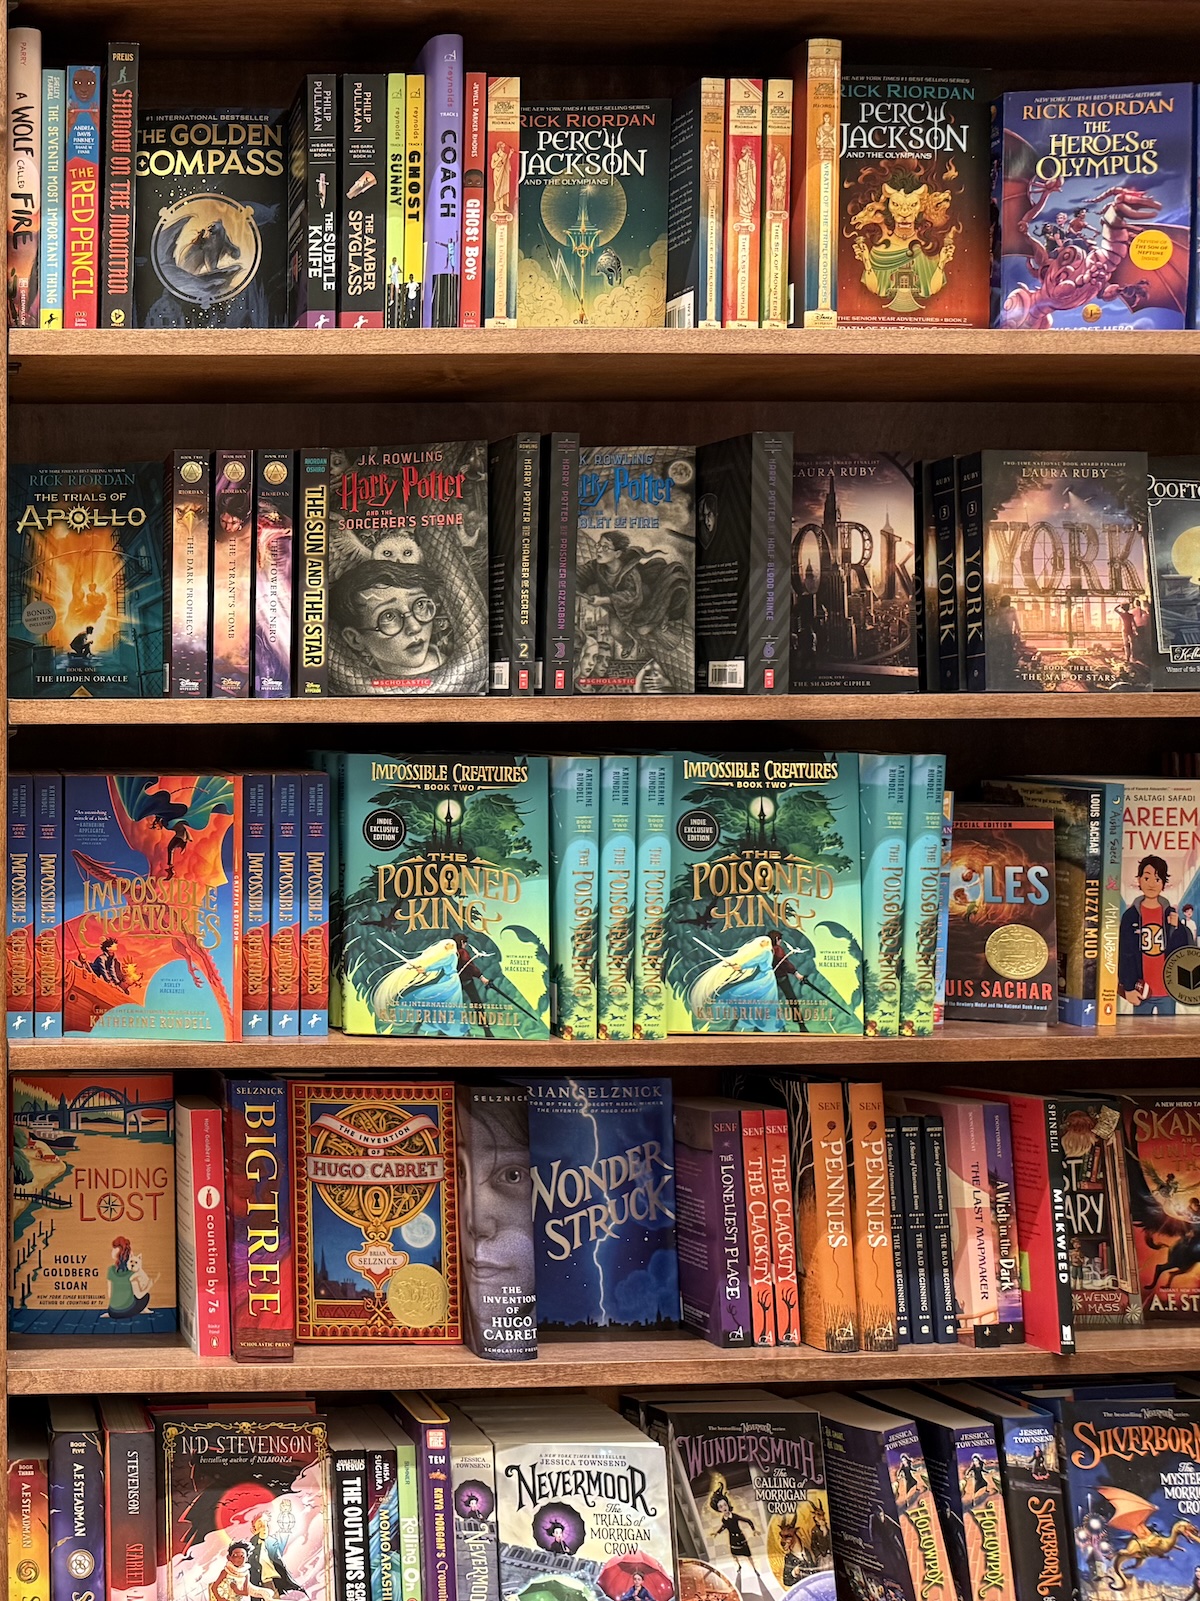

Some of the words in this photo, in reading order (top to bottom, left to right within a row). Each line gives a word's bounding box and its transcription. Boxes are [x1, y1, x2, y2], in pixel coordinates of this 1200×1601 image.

[112, 52, 134, 61] PREUS
[1022, 103, 1072, 120] RICK
[1077, 99, 1174, 117] RIORDAN
[12, 106, 34, 156] WOLF
[537, 128, 623, 150] PERCY
[1049, 133, 1139, 157] HEROES
[1142, 140, 1156, 149] OF
[70, 166, 94, 179] THE
[441, 131, 457, 218] COACH
[1035, 151, 1158, 181] OLYMPUS
[70, 181, 95, 223] RED
[12, 193, 34, 250] FIRE
[70, 228, 95, 301] PENCIL
[1022, 468, 1069, 478] LAURA
[1073, 469, 1108, 478] RUBY
[402, 466, 466, 515] Potter
[16, 503, 147, 534] APOLLO
[377, 865, 521, 904] POISONED
[1086, 878, 1099, 922] FUZZY
[1085, 923, 1097, 959] MUD
[1141, 927, 1164, 951] 34
[980, 982, 1052, 1000] SACHAR
[339, 1125, 356, 1136] THE
[359, 1126, 410, 1143] INVENTION
[714, 1123, 737, 1132] SENF
[244, 1101, 278, 1183] BIG
[74, 1167, 168, 1189] FINDING
[313, 1162, 365, 1177] HUGO
[371, 1160, 438, 1177] CABRET
[821, 1139, 848, 1248] PENNIES
[1053, 1189, 1067, 1284] MILKWEED
[246, 1190, 281, 1317] TREE
[43, 1267, 99, 1277] GOLDBERG
[54, 1280, 87, 1290] SLOAN
[1083, 1293, 1122, 1303] WENDY
[505, 1464, 657, 1517] NEVERMOOR
[755, 1490, 806, 1501] MORRIGAN
[593, 1514, 630, 1527] TRIALS
[632, 1514, 643, 1526] of
[591, 1528, 650, 1541] MORRIGAN
[1028, 1497, 1062, 1594] SILVERBORN
[605, 1542, 638, 1556] CROW
